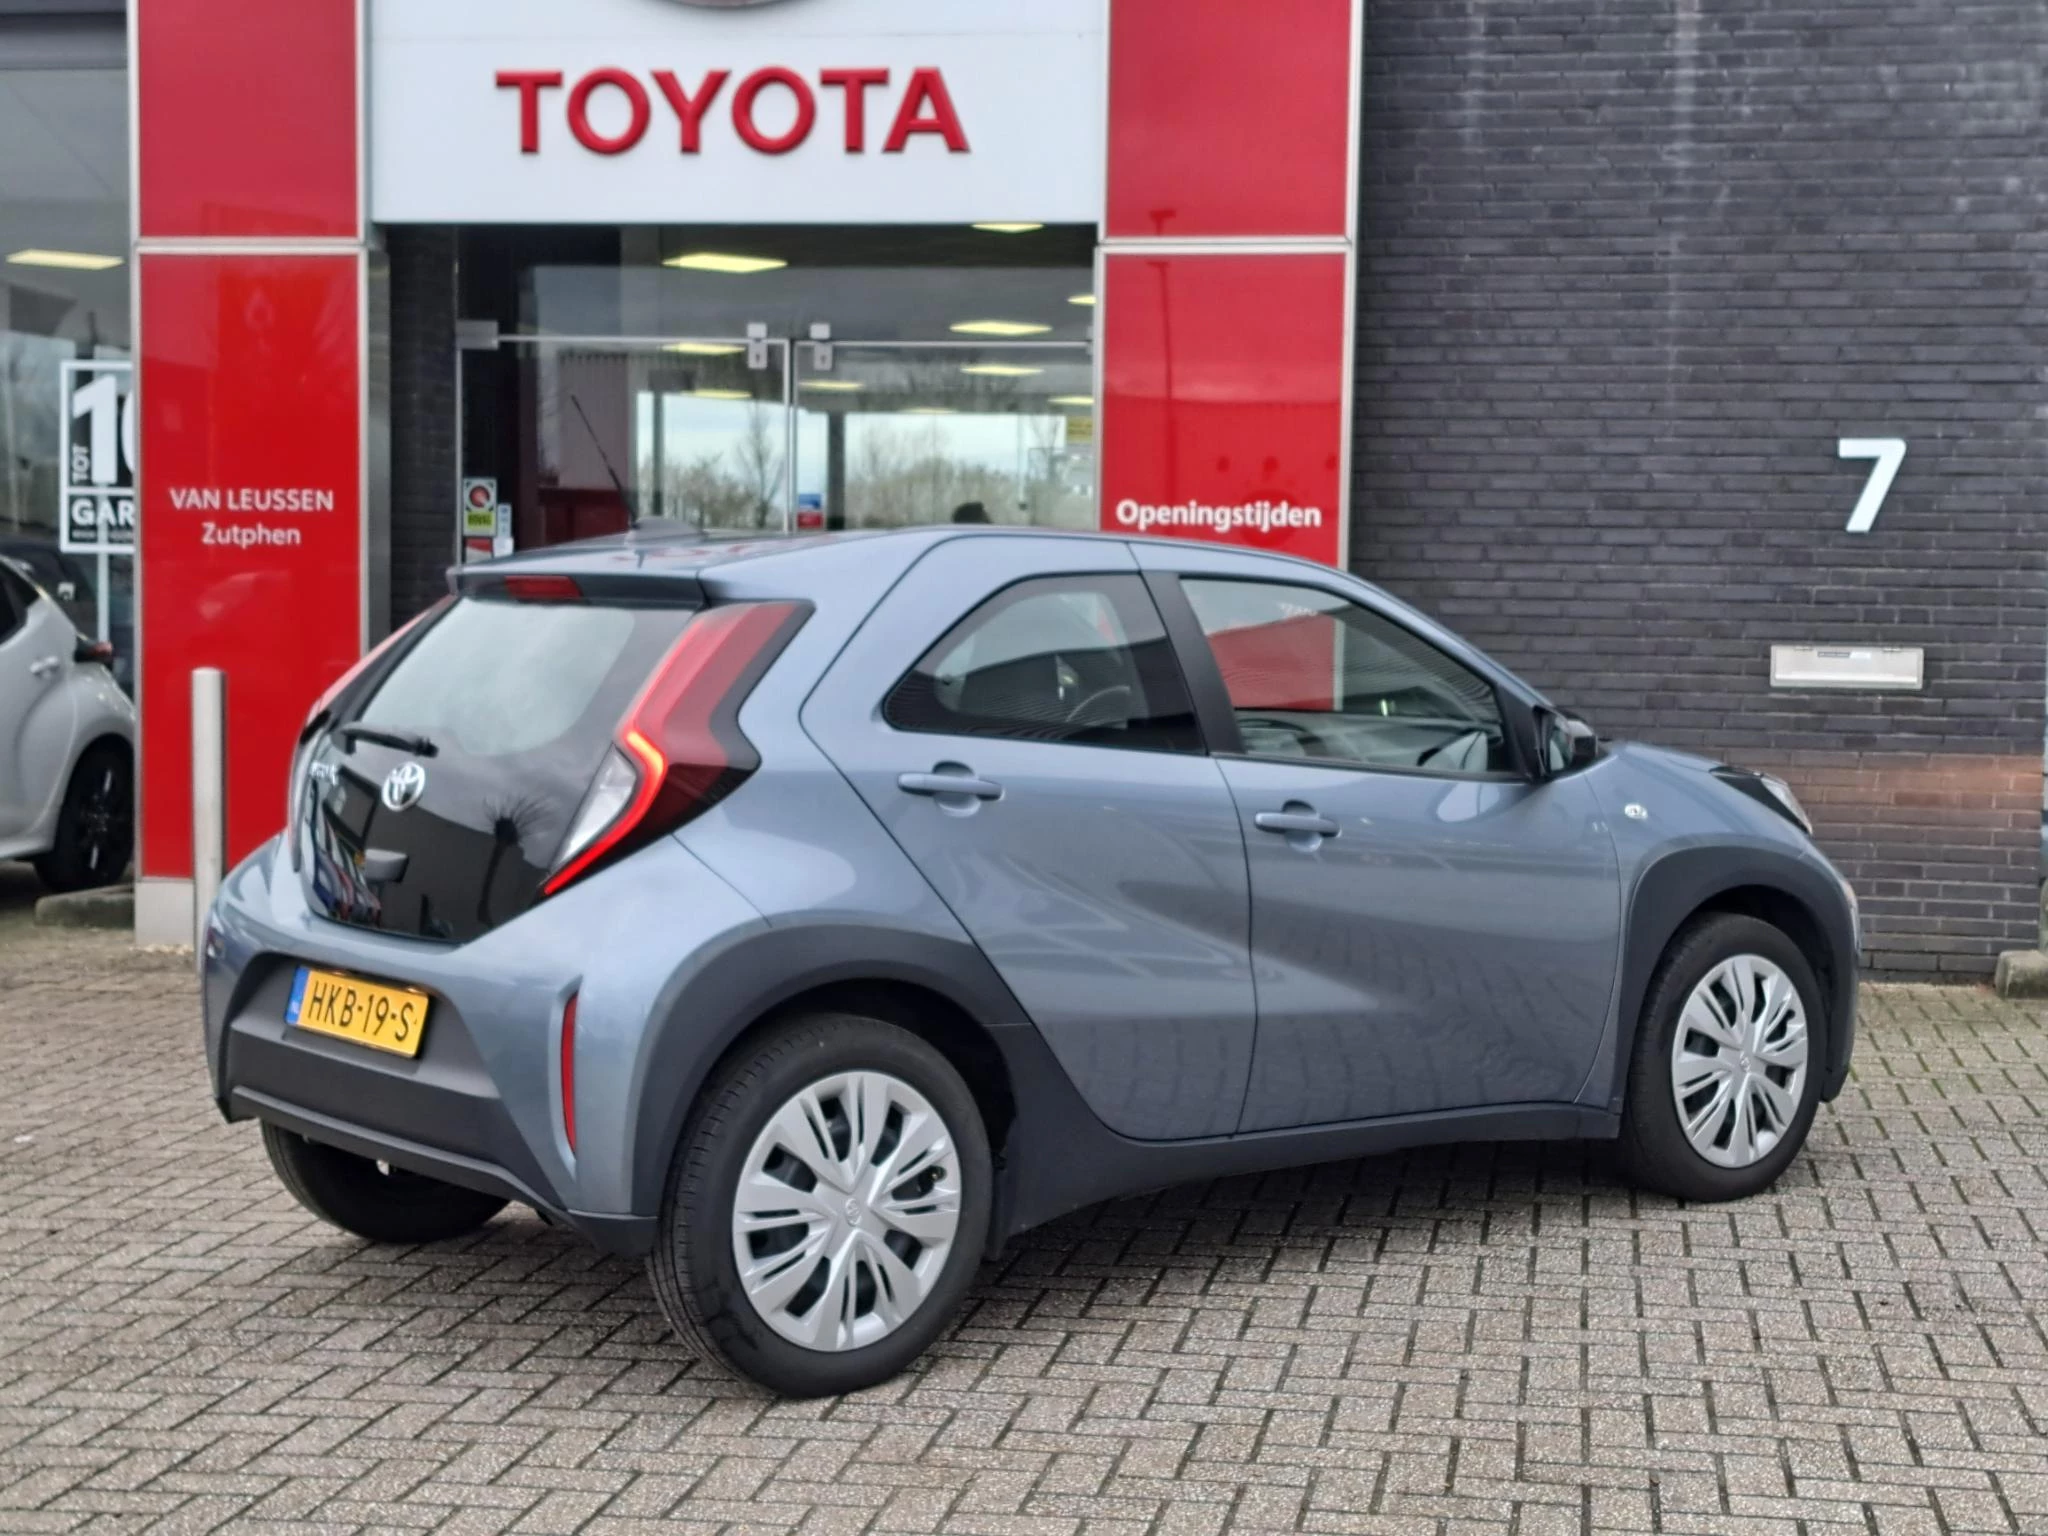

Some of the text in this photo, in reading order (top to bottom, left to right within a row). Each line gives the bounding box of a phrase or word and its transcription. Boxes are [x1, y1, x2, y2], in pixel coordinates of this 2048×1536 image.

[496, 66, 970, 154] TOYOTA
[72, 444, 90, 484] TOT
[169, 488, 335, 511] VAN LEUSSEN
[1838, 437, 1907, 533] 7
[201, 522, 302, 549] Zutphen
[1115, 498, 1323, 534] Openingstijden
[308, 979, 416, 1043] HKB-19-S
